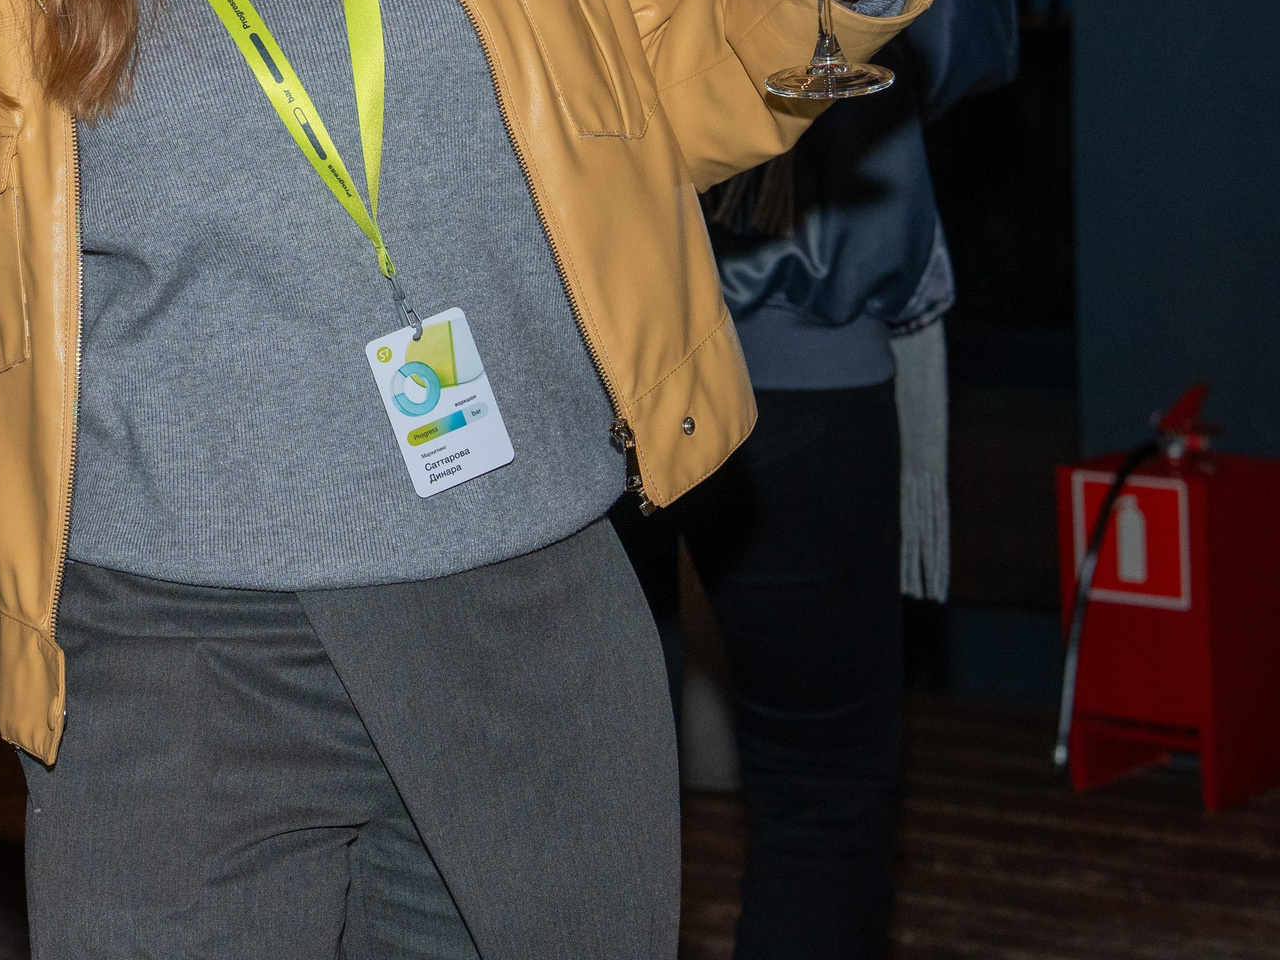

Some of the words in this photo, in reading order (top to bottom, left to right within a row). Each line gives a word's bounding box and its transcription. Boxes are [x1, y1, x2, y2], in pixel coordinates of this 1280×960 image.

[283, 89, 295, 104] bar
[328, 164, 352, 197] Progress
[413, 426, 439, 441] Progress
[470, 408, 482, 417] bar
[421, 445, 447, 459] Маркетинг
[424, 447, 471, 472] Саттарова
[429, 463, 462, 484] Динара
